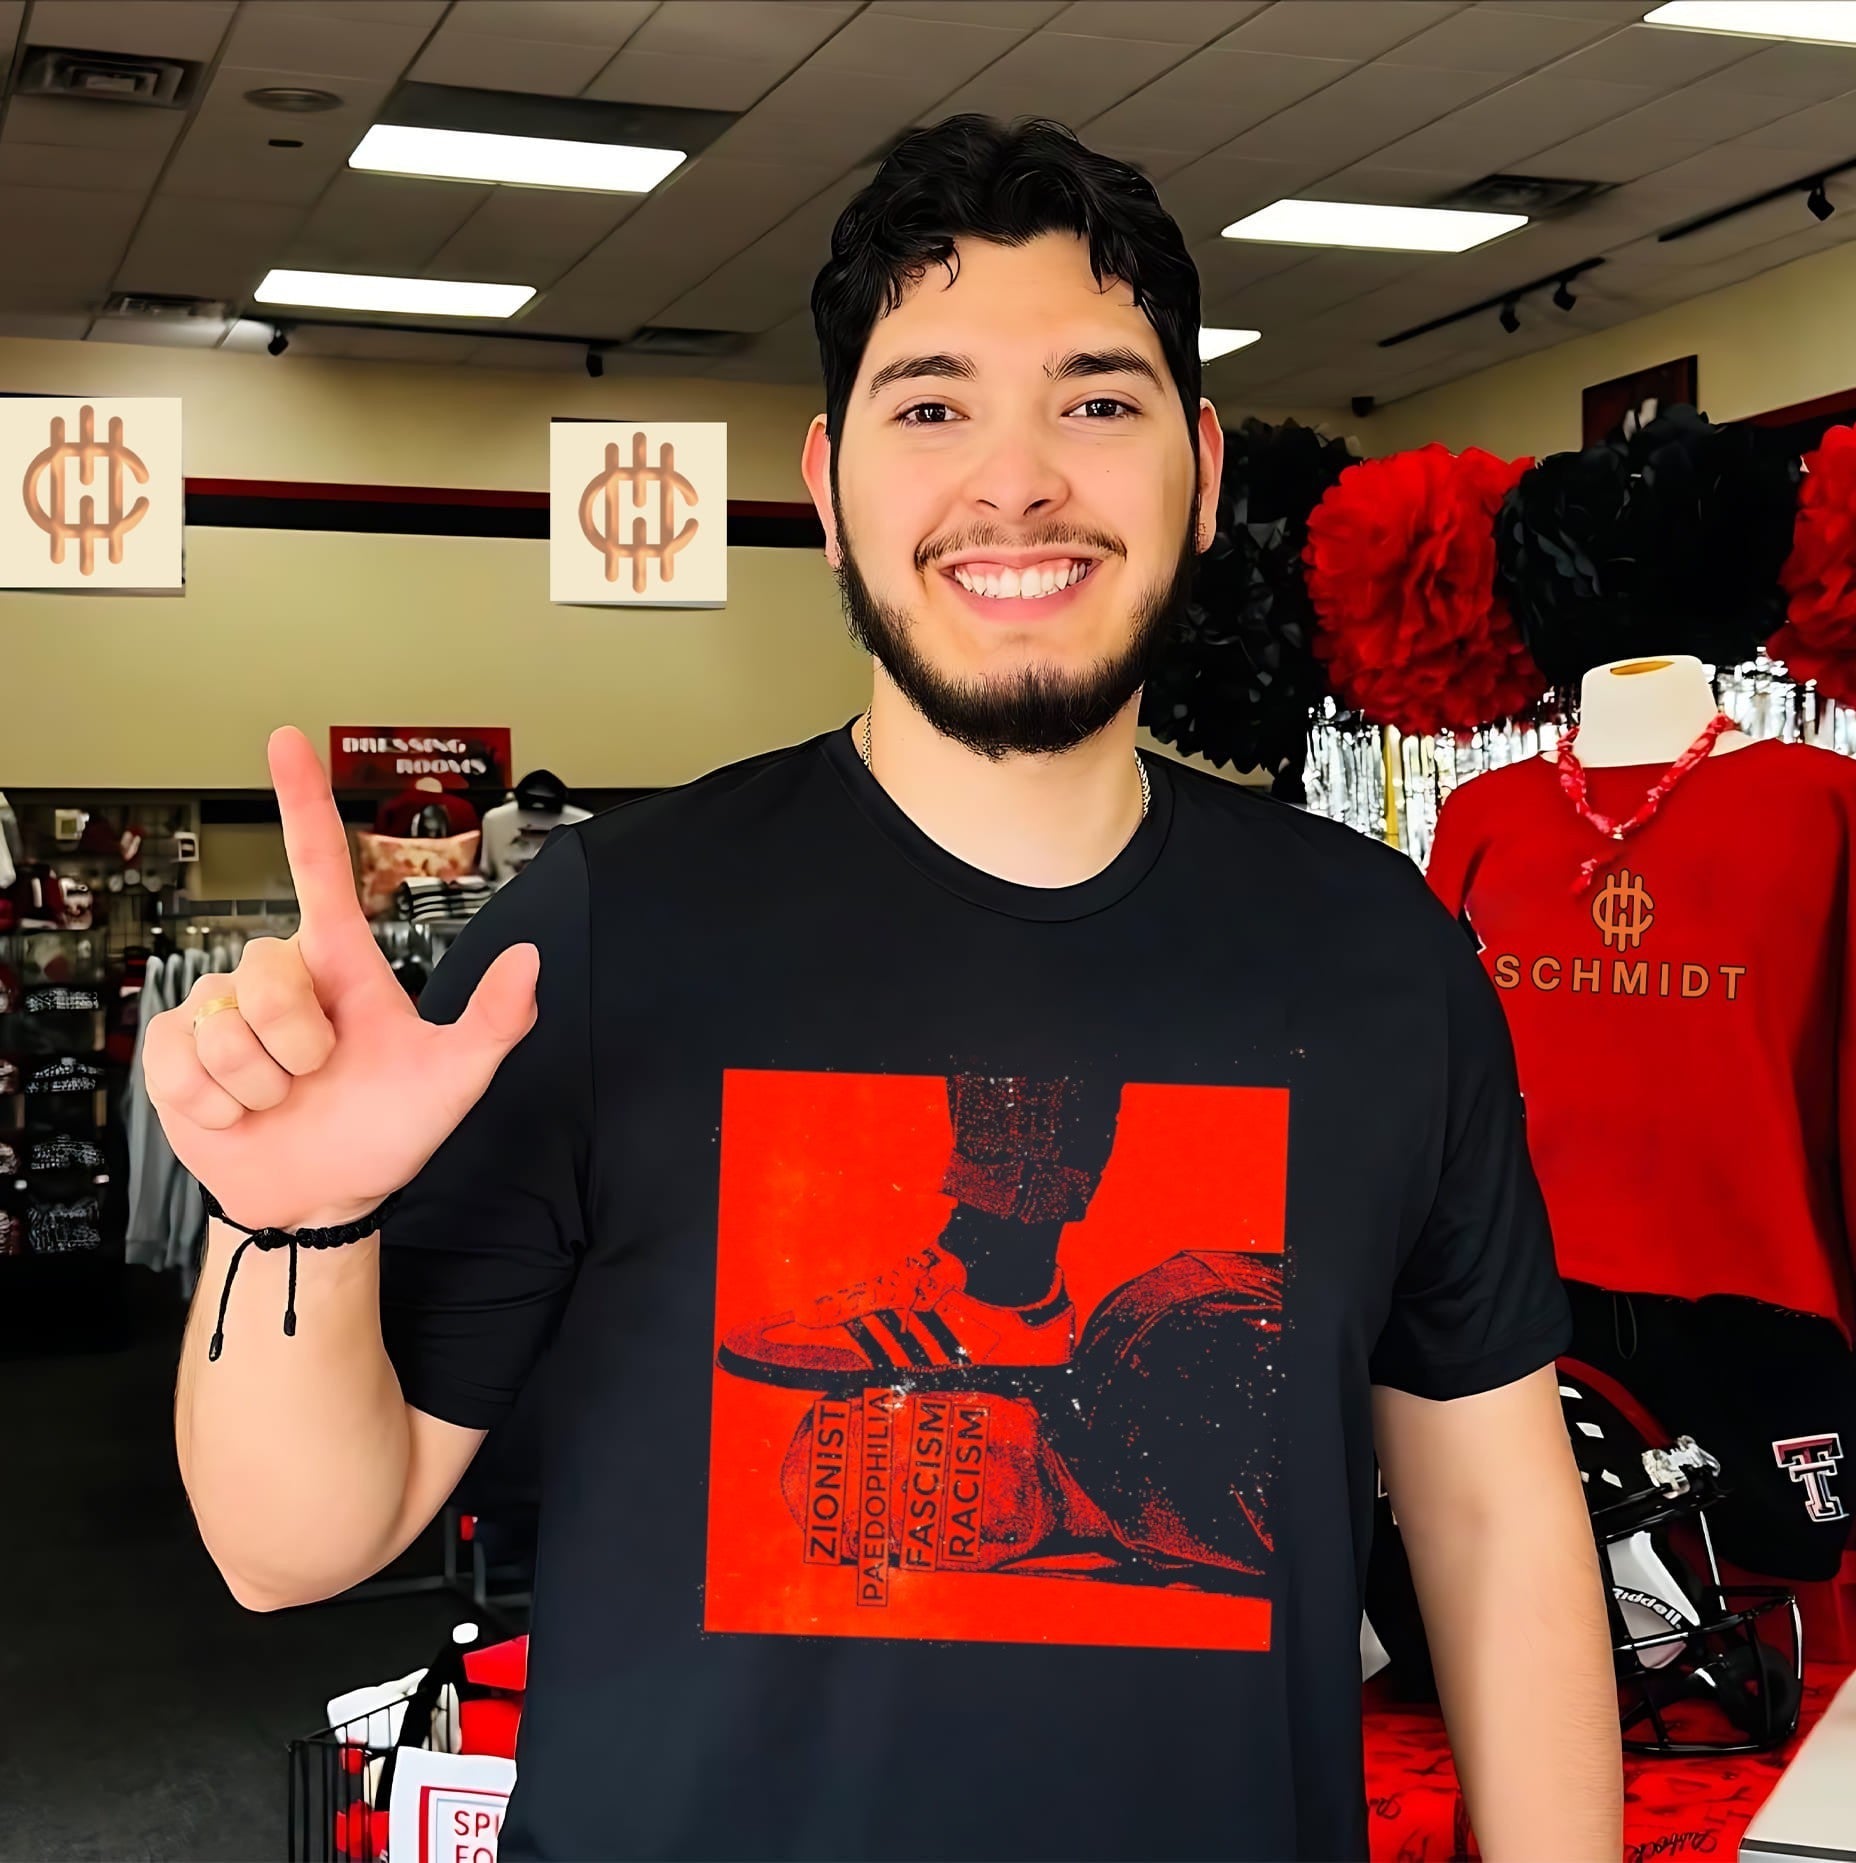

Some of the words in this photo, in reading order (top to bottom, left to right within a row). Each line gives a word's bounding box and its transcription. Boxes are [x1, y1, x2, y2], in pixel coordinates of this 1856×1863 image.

[396, 758, 487, 774] ROOMS
[1495, 954, 1746, 999] SCHMIDT
[810, 1405, 845, 1559] ZIONIST
[862, 1393, 890, 1600] PAEDOPHILIA
[906, 1402, 946, 1567] FASCISM
[950, 1410, 987, 1557] RACISM
